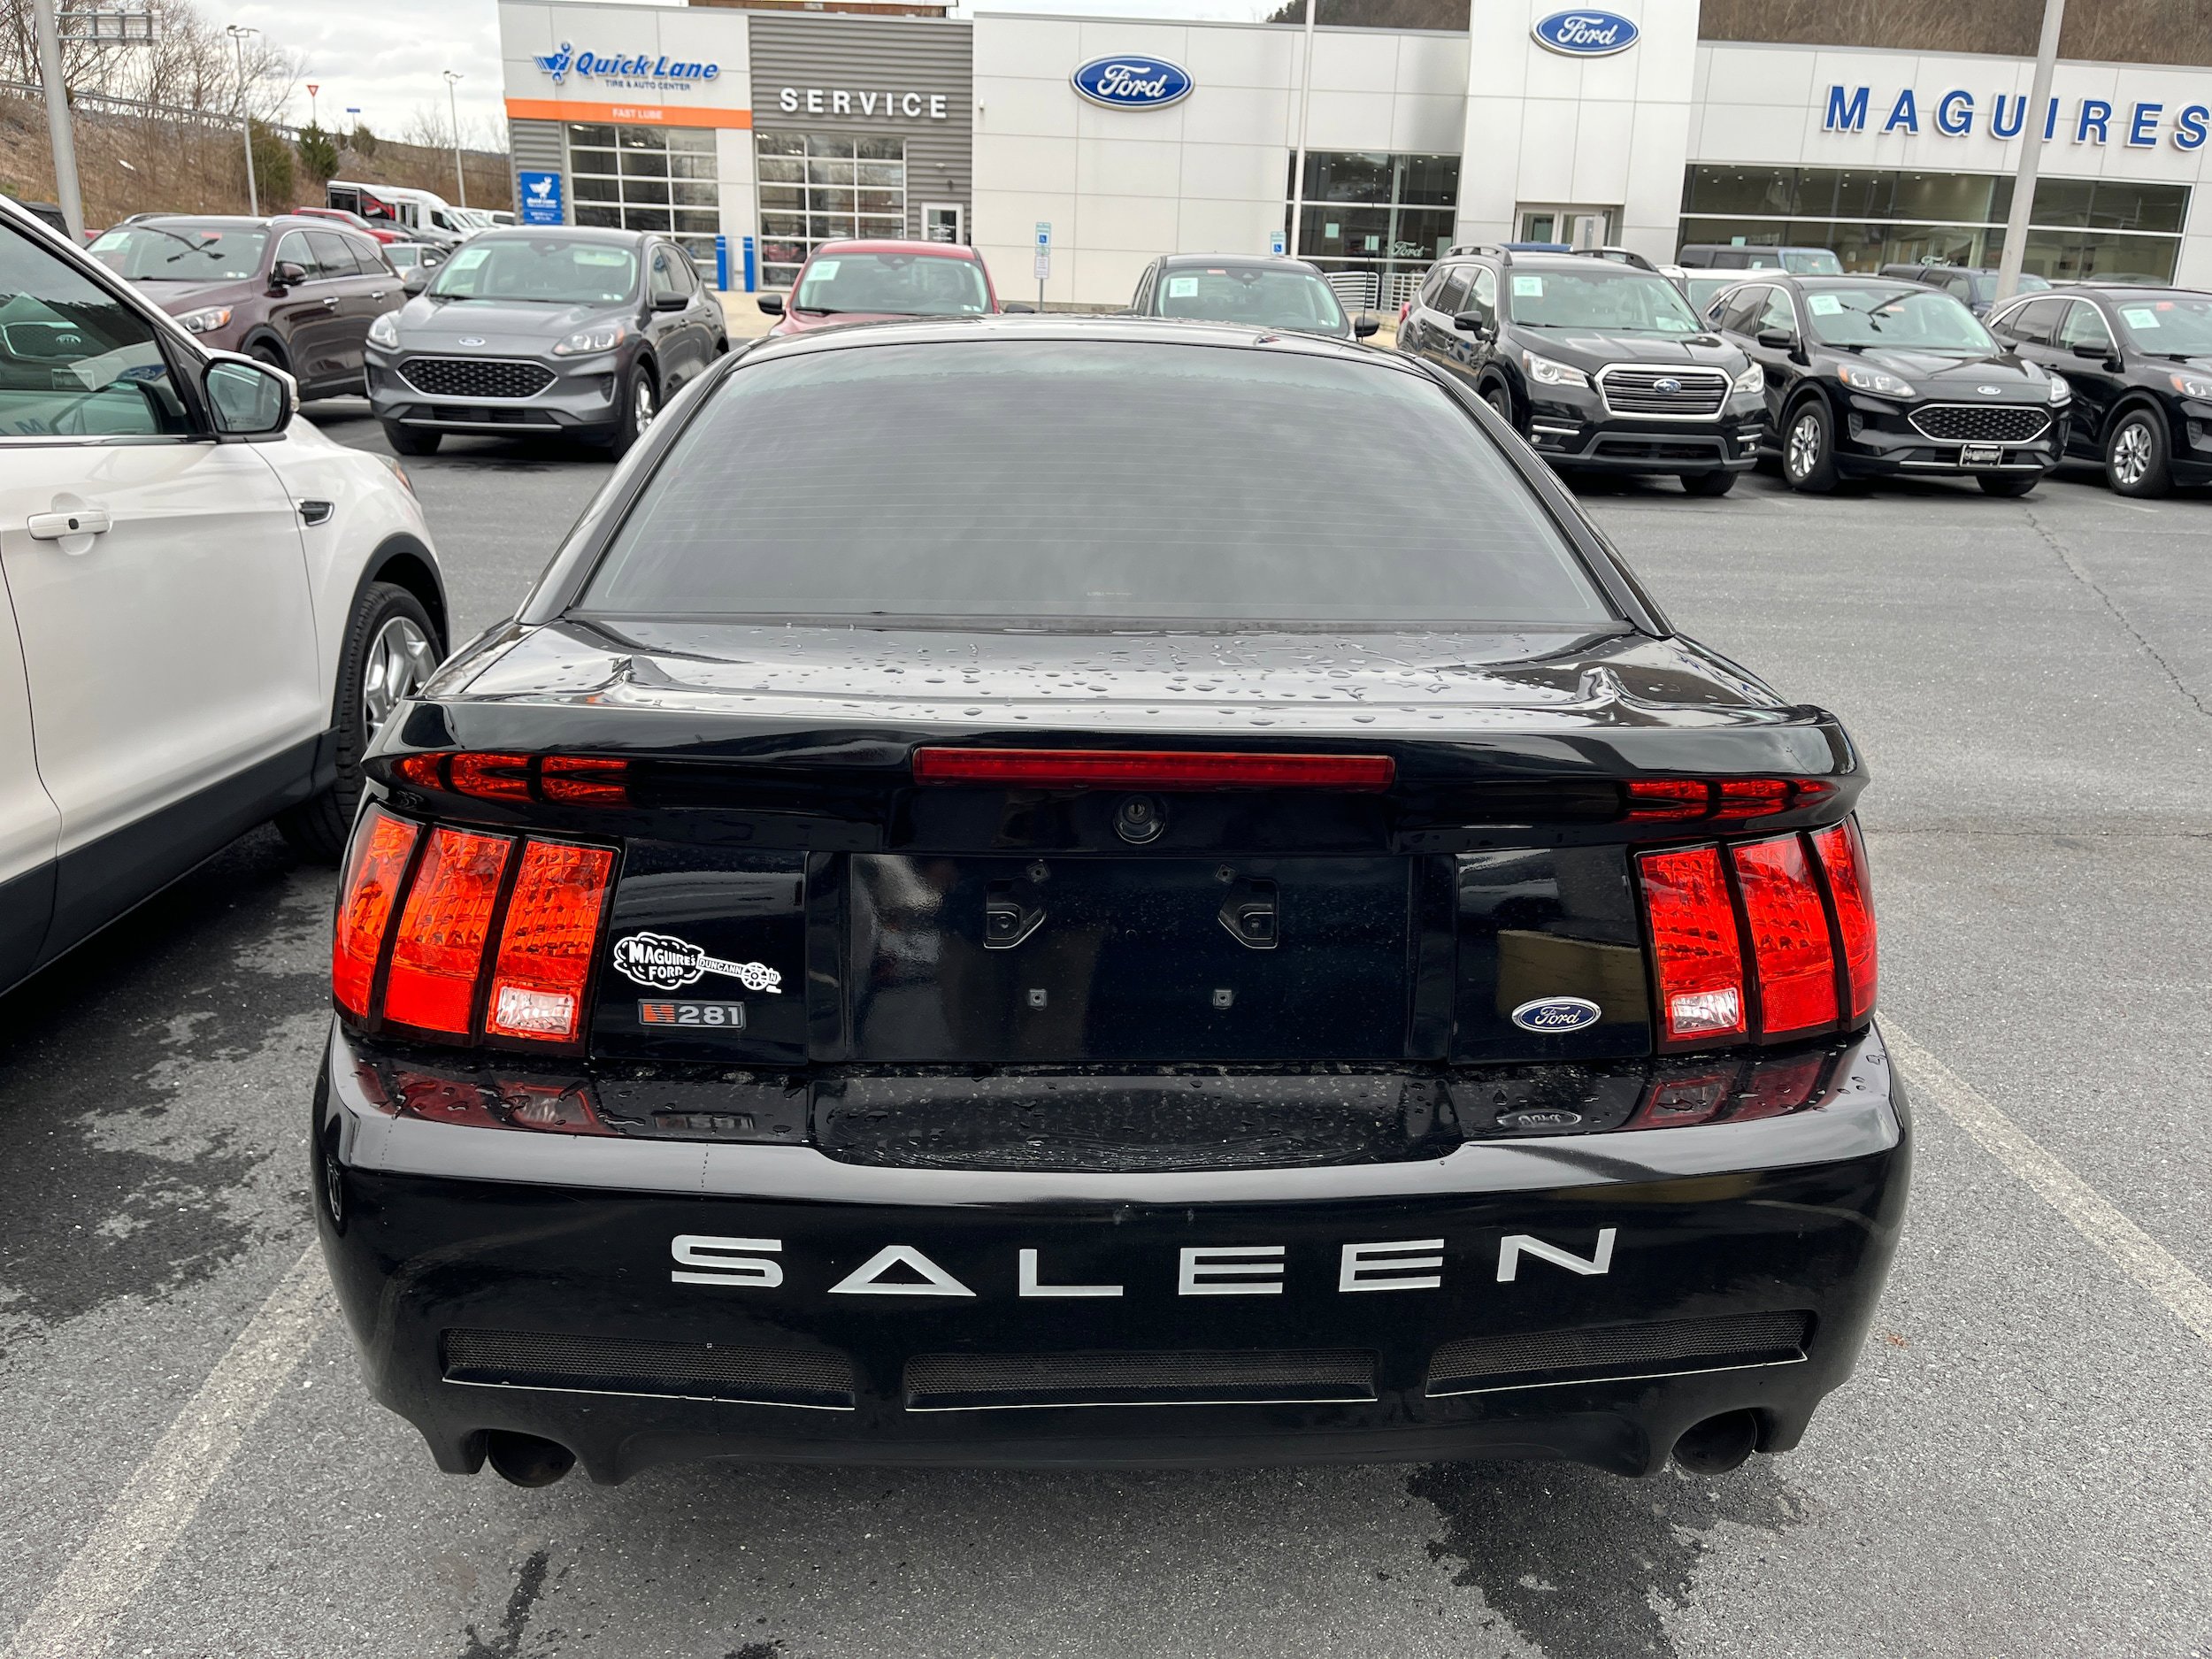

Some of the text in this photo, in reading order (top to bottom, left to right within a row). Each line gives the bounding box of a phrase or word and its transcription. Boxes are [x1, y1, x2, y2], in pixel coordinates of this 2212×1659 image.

[1556, 15, 1618, 45] Ford
[575, 52, 718, 80] Quick Lane
[605, 79, 624, 88] TIRE
[634, 81, 656, 89] AUTO
[657, 82, 691, 91] CENTER
[1097, 64, 1168, 97] Ford
[611, 108, 664, 120] FAST LUBE
[780, 87, 948, 119] SERVICE
[1824, 84, 2210, 150] MAGUIRES
[1391, 241, 1425, 257] Ford
[649, 965, 684, 980] FORD
[678, 1005, 739, 1025] 281
[1534, 1006, 1581, 1025] Ford
[671, 1227, 1618, 1297] SALEEN
